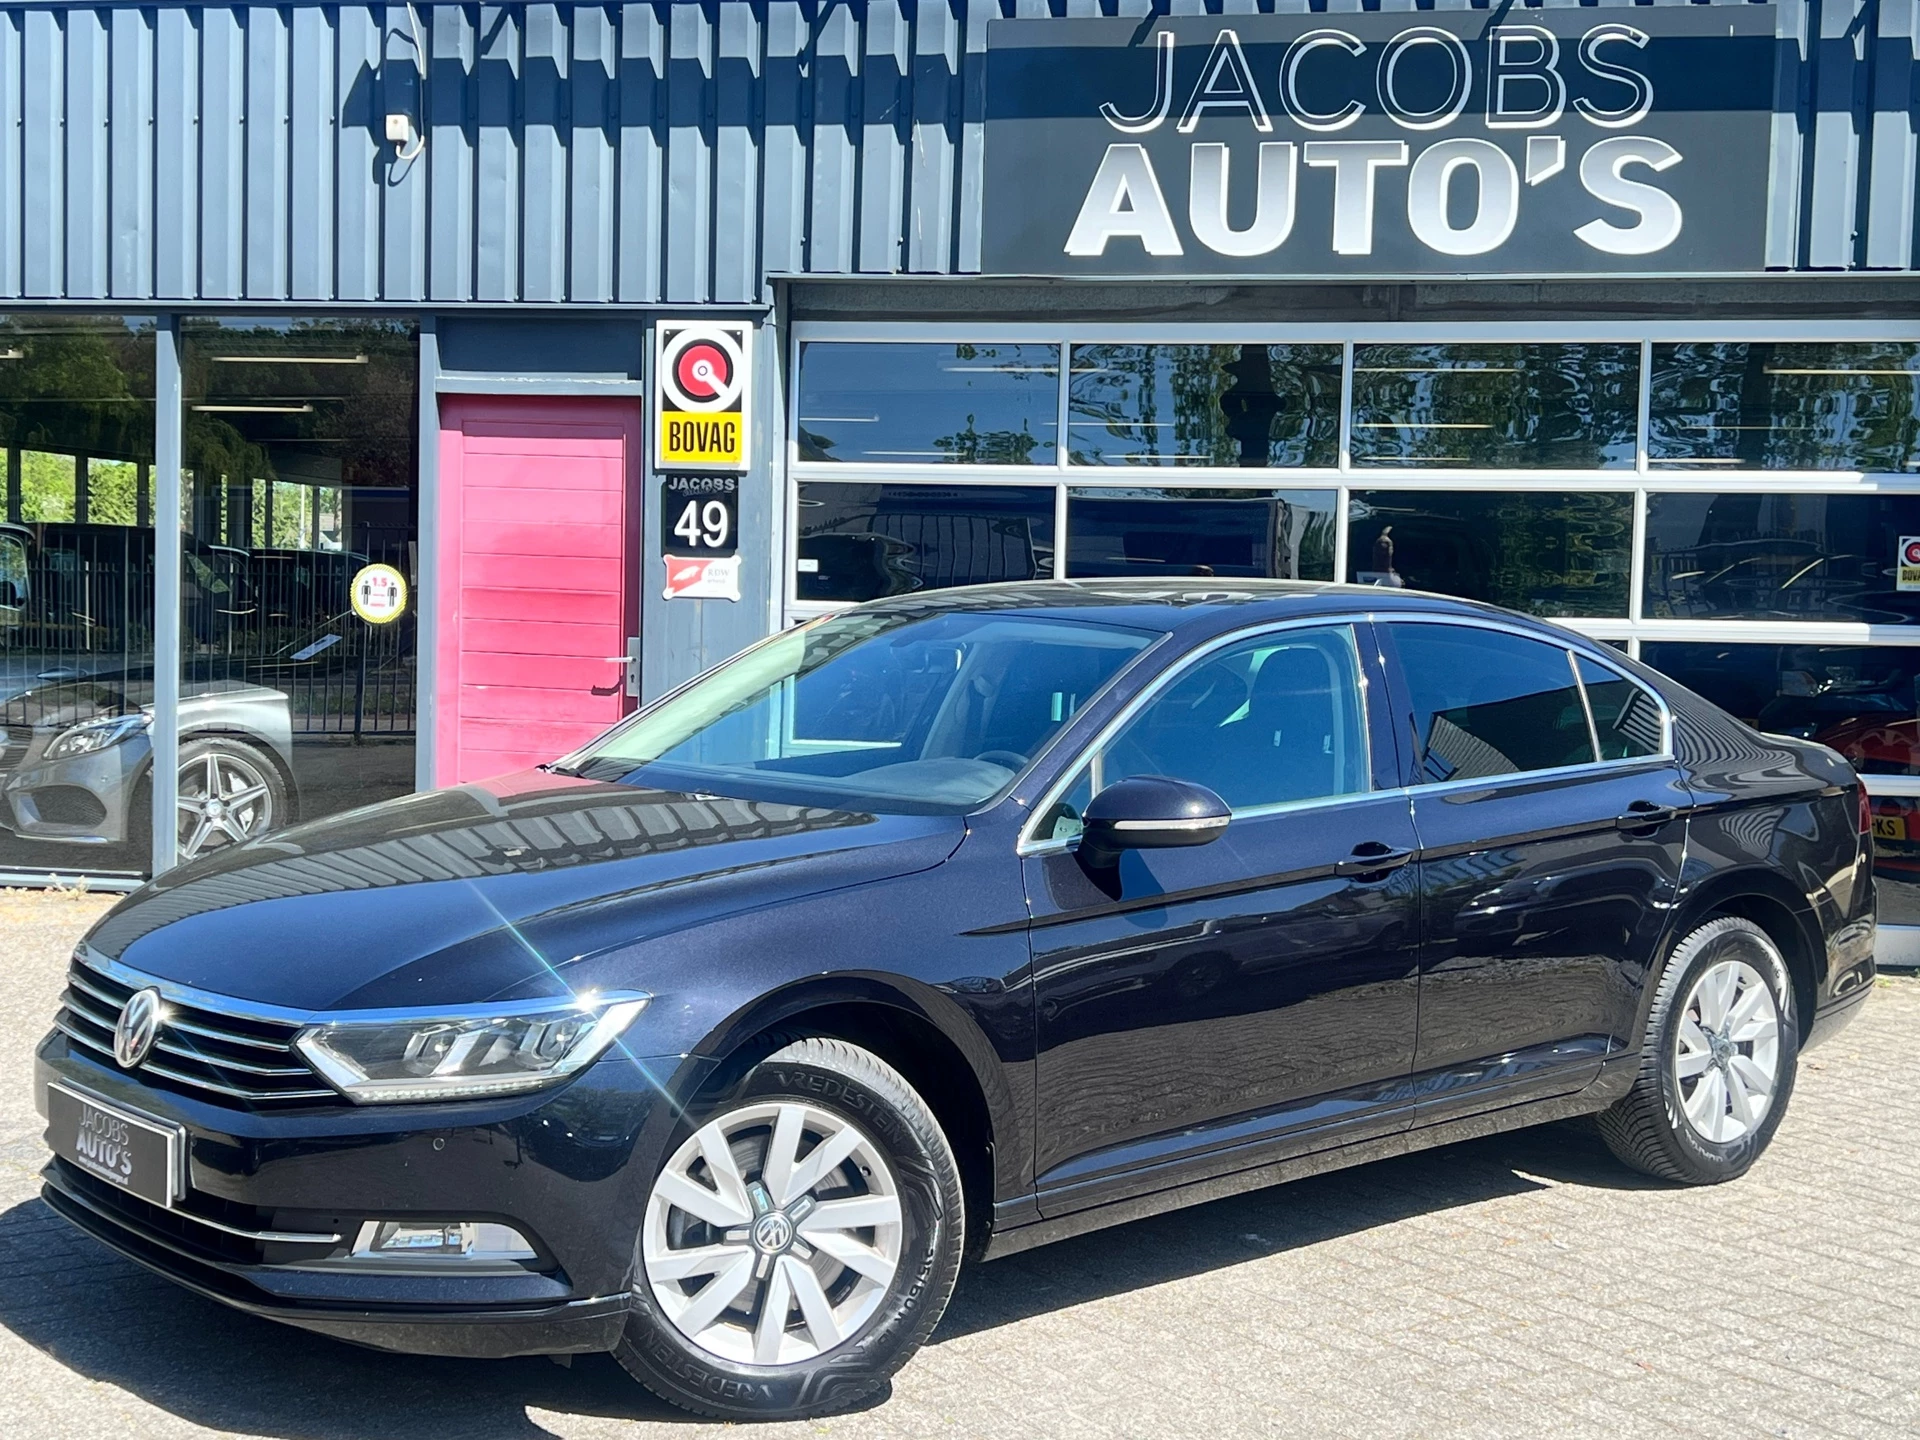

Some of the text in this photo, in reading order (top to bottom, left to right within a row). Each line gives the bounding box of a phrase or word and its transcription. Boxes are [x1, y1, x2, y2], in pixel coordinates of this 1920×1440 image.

[1098, 24, 1655, 132] JACOBS
[1064, 136, 1684, 257] AUTO'S
[669, 421, 735, 453] BOVAG
[668, 477, 735, 492] JACOBS
[673, 499, 729, 548] 49
[79, 1103, 129, 1146] JACOBS
[772, 1070, 908, 1145] VREDESTEIN
[75, 1127, 132, 1175] AUTO'S
